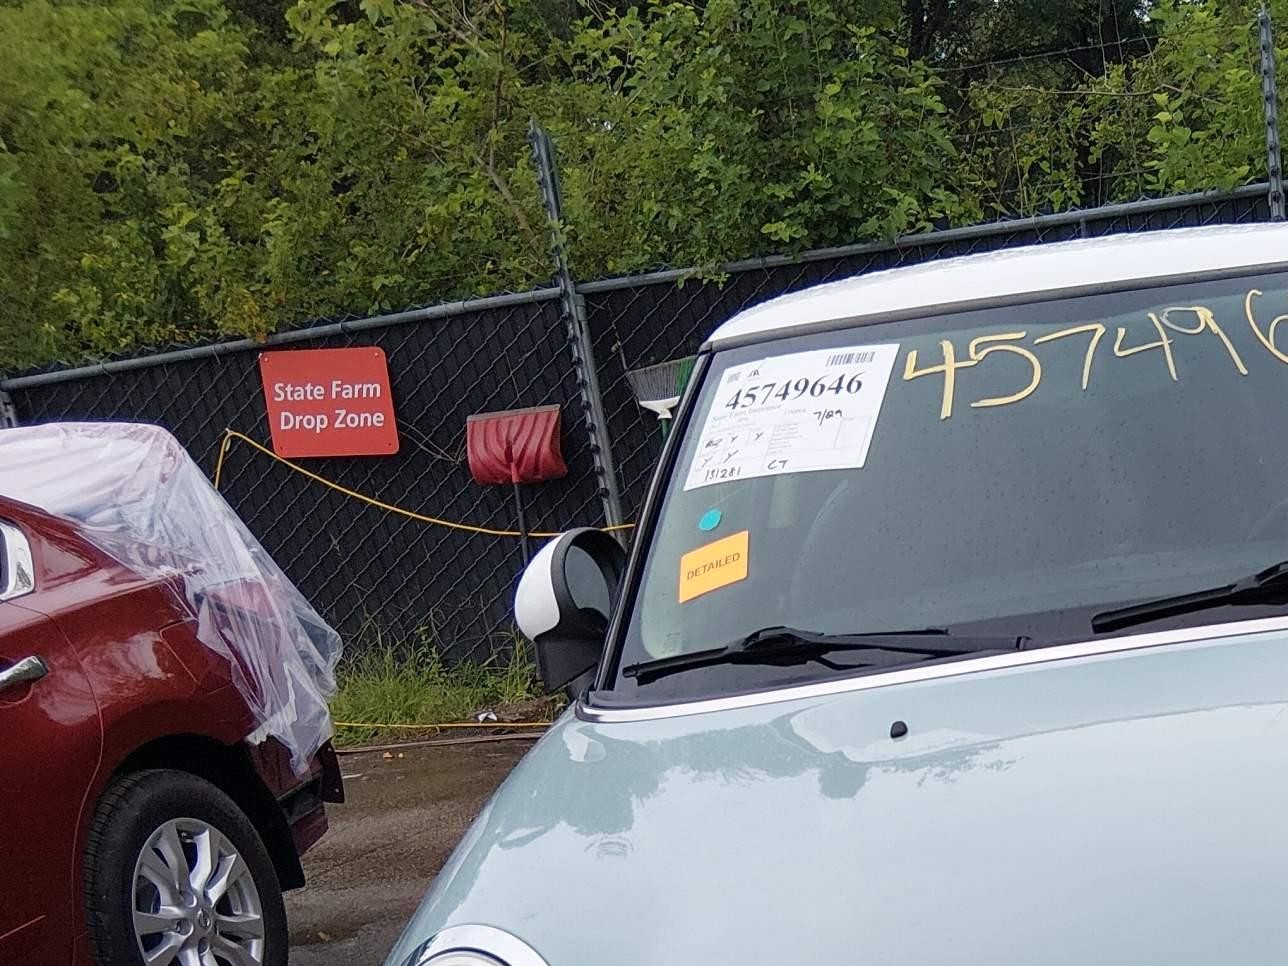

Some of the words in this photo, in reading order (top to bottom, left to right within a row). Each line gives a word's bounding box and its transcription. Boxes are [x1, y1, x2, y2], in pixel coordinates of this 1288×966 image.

[274, 382, 325, 401] State
[331, 380, 381, 399] Farm
[725, 371, 865, 410] 45749646
[280, 411, 328, 433] Drop
[334, 409, 385, 428] Zone
[686, 552, 741, 581] DETAILED
